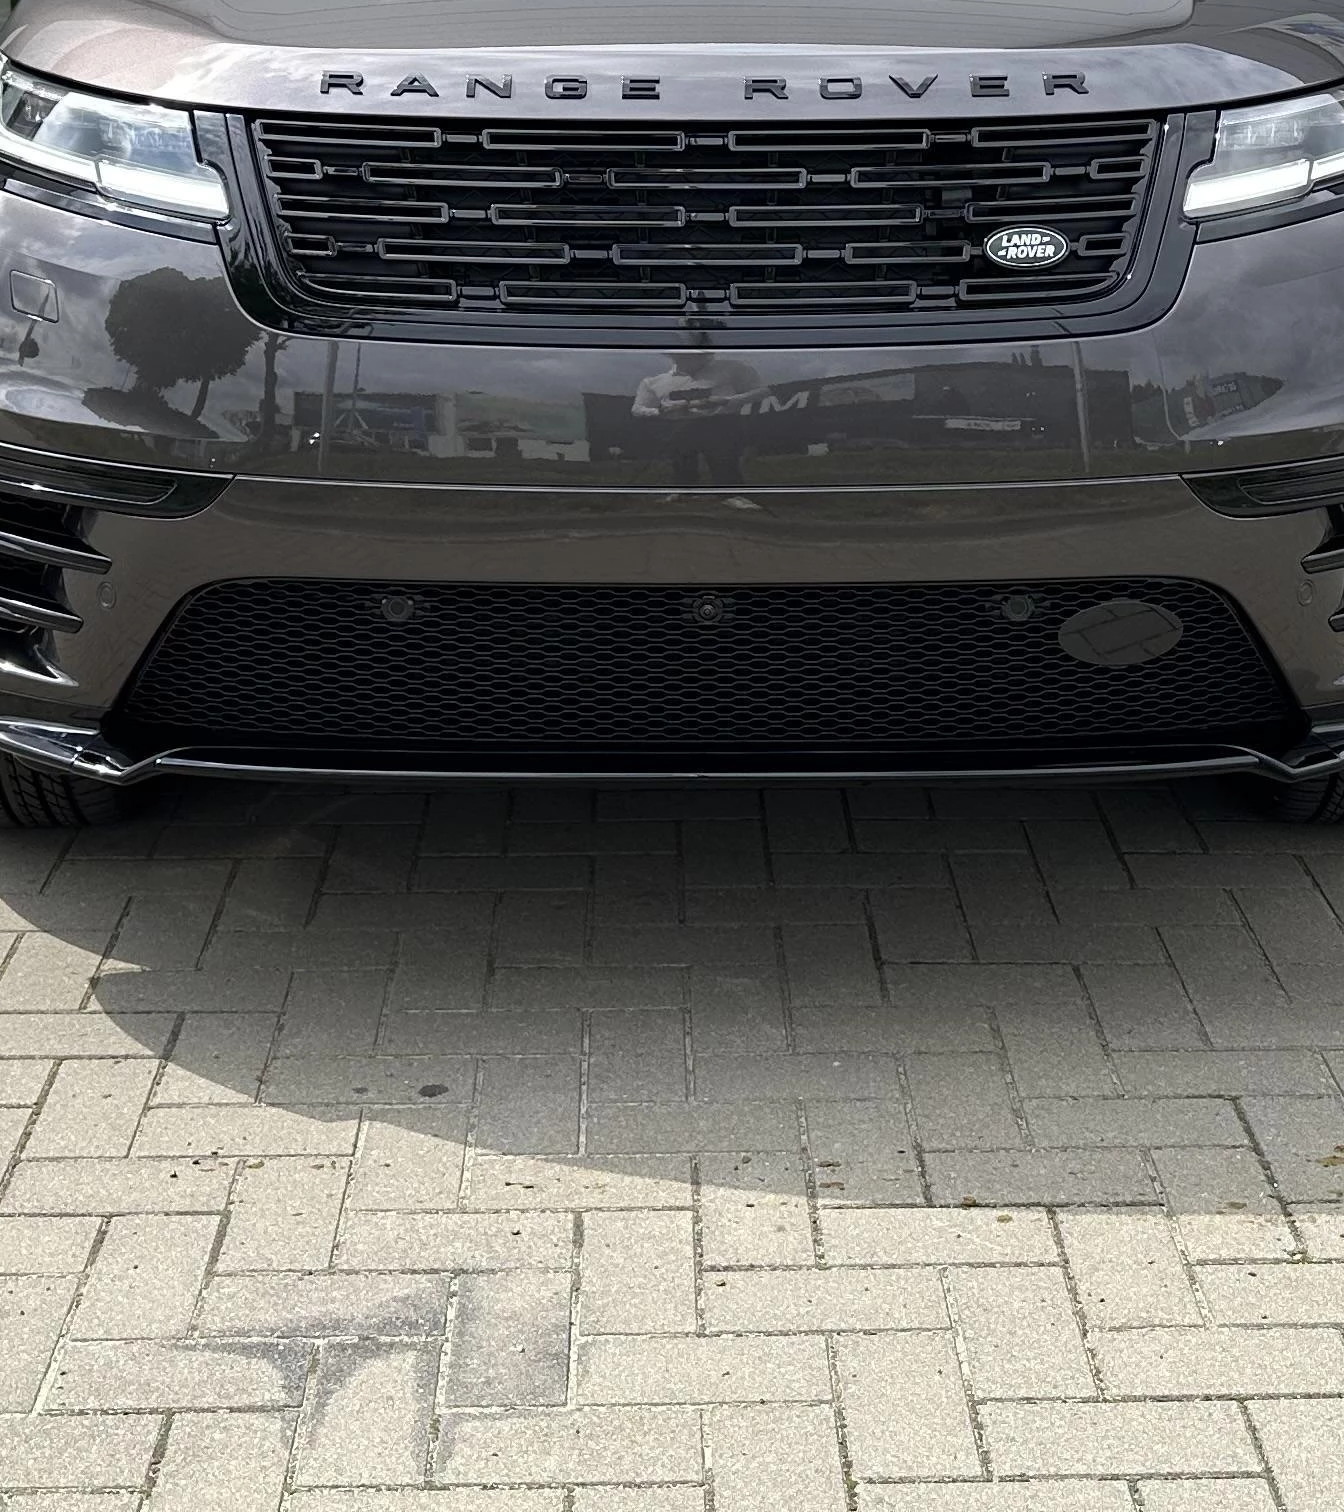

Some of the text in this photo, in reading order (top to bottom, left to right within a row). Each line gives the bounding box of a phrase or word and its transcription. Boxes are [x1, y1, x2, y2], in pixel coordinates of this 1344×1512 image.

[320, 70, 1090, 100] RANGE ROVER
[1001, 233, 1042, 247] LAND
[1006, 244, 1055, 259] ROVER
